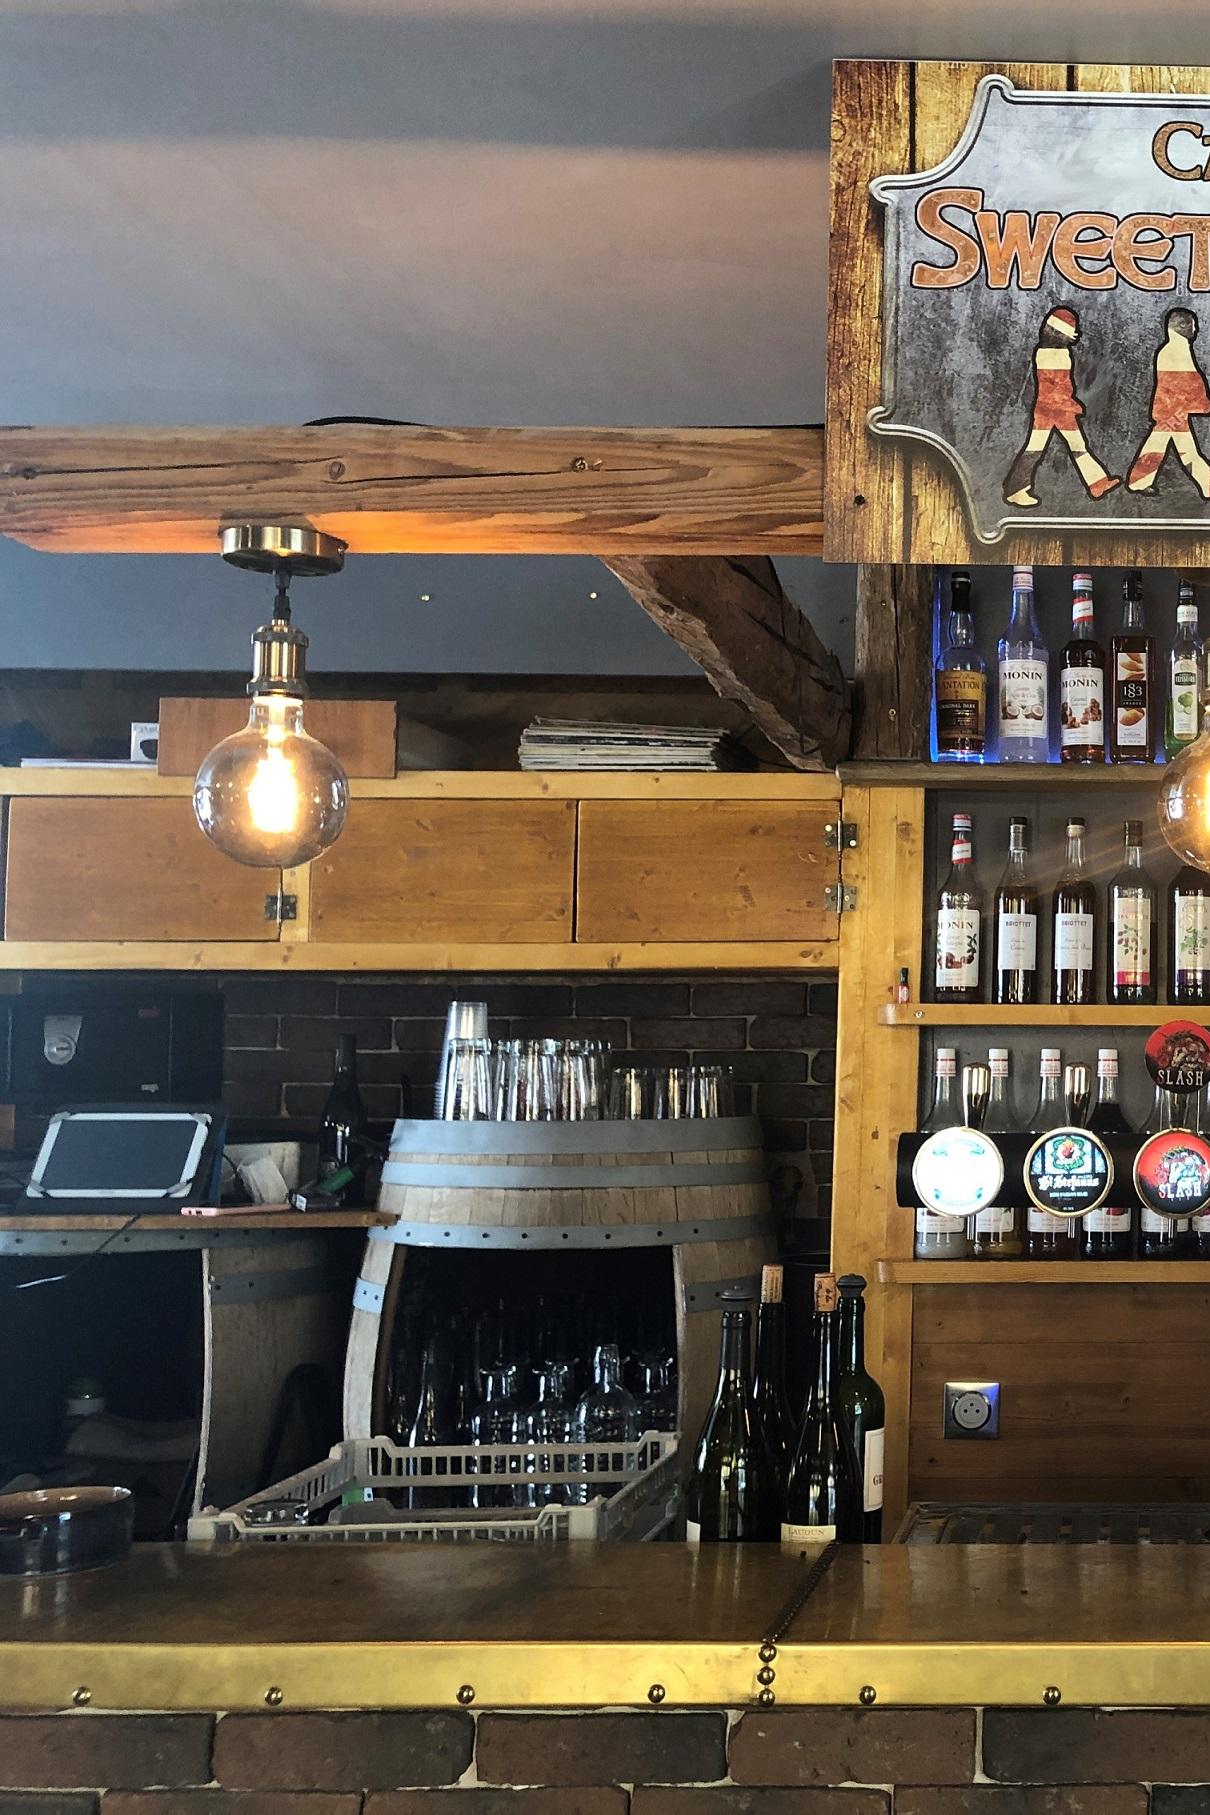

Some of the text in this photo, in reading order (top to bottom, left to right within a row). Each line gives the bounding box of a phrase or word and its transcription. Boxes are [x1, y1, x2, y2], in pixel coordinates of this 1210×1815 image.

[1003, 671, 1043, 680] MONIN
[1062, 679, 1098, 688] MONIN
[1157, 1069, 1203, 1086] SLASH
[1158, 1182, 1202, 1199] SLASH
